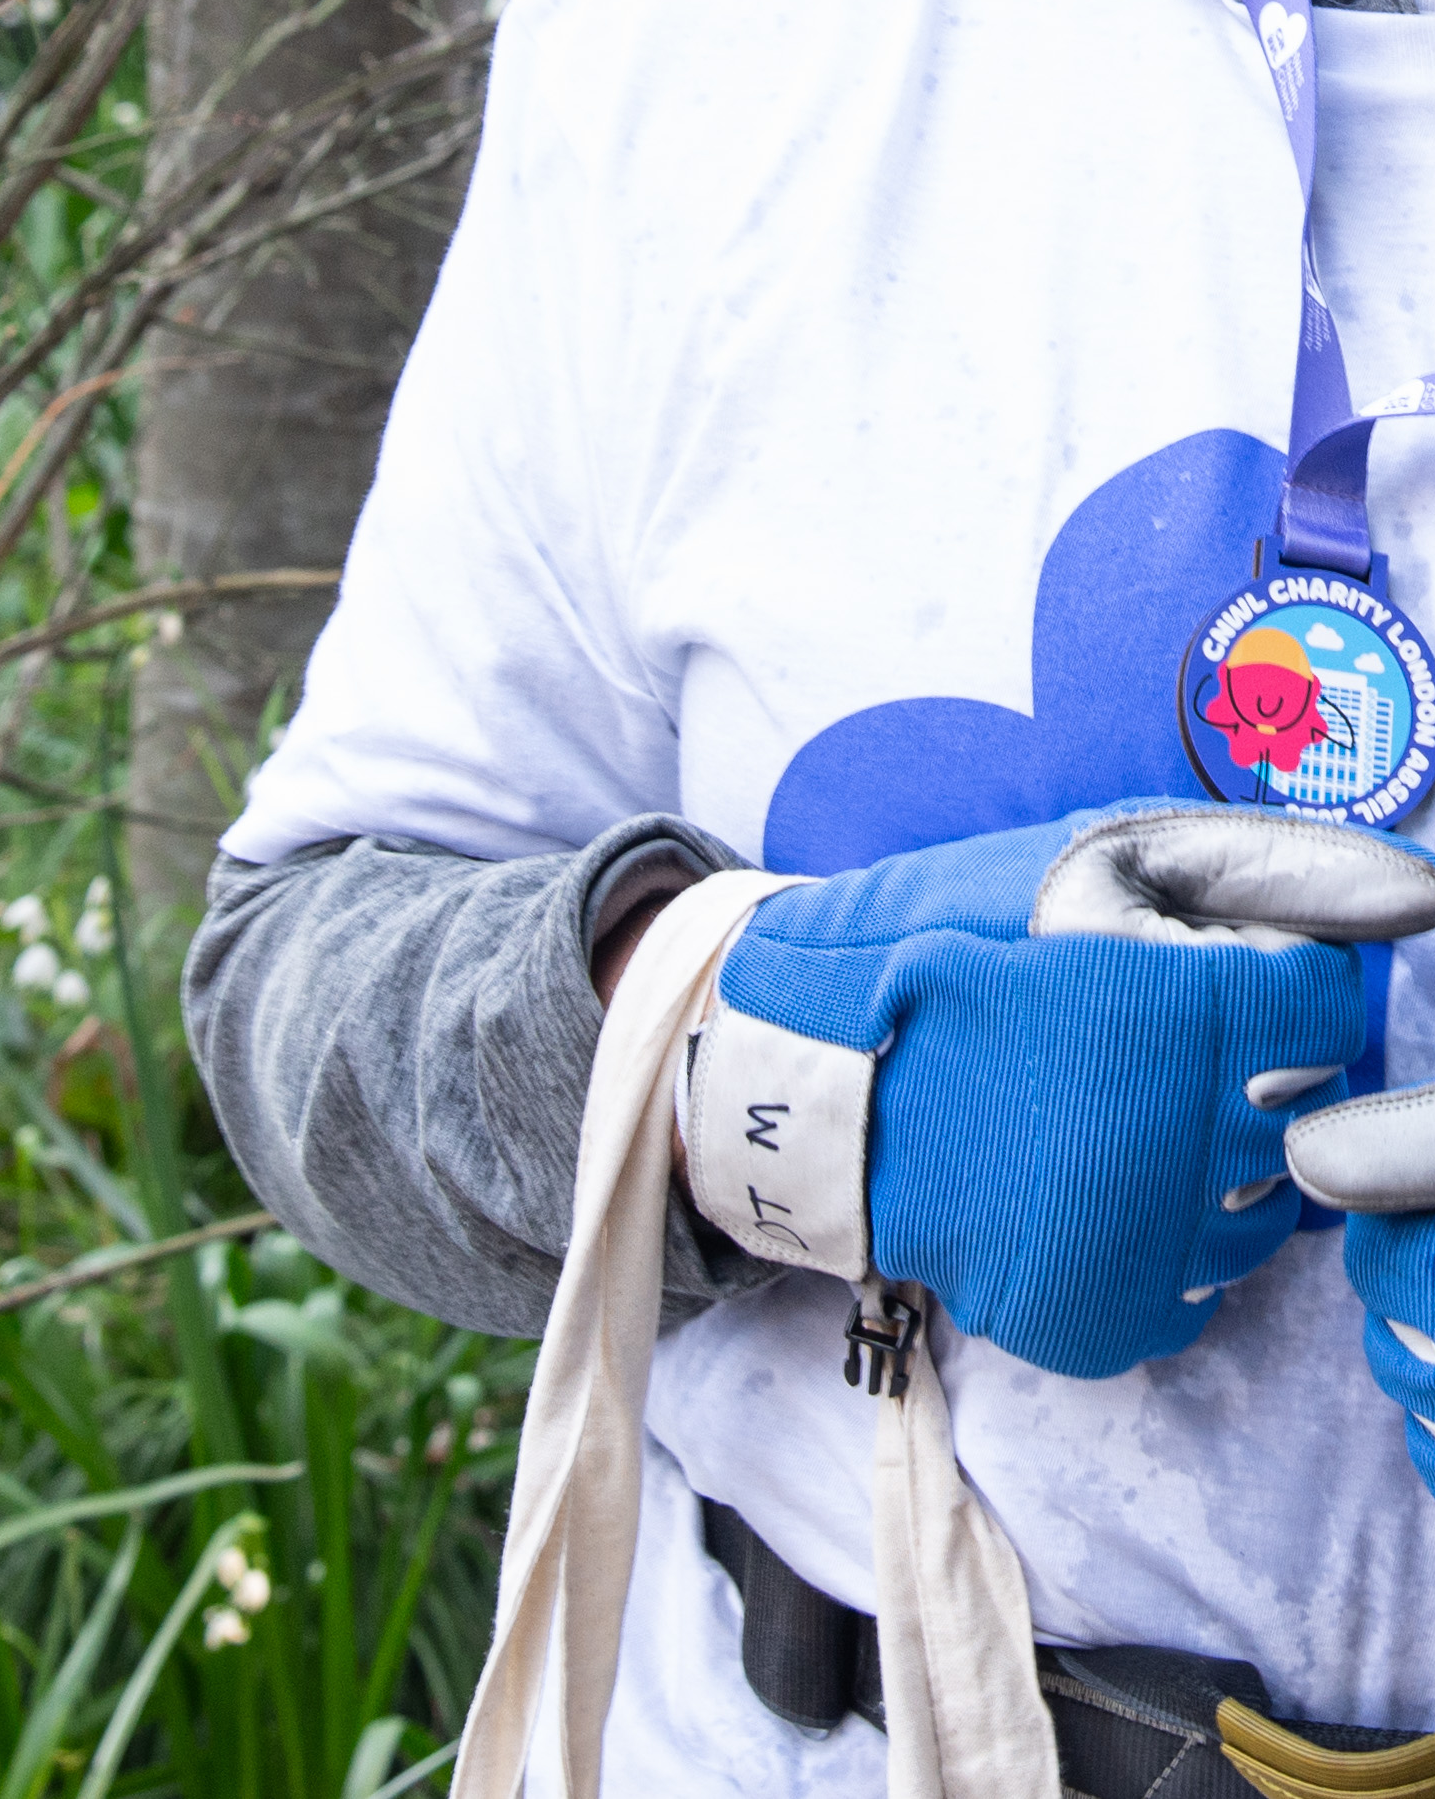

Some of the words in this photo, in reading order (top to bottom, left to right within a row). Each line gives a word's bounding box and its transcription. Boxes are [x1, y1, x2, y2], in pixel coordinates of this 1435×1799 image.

[1202, 591, 1269, 663] CNWL
[1268, 576, 1393, 628] CHARITY
[1352, 747, 1431, 825] ABSEIL
[745, 1103, 790, 1152] M
